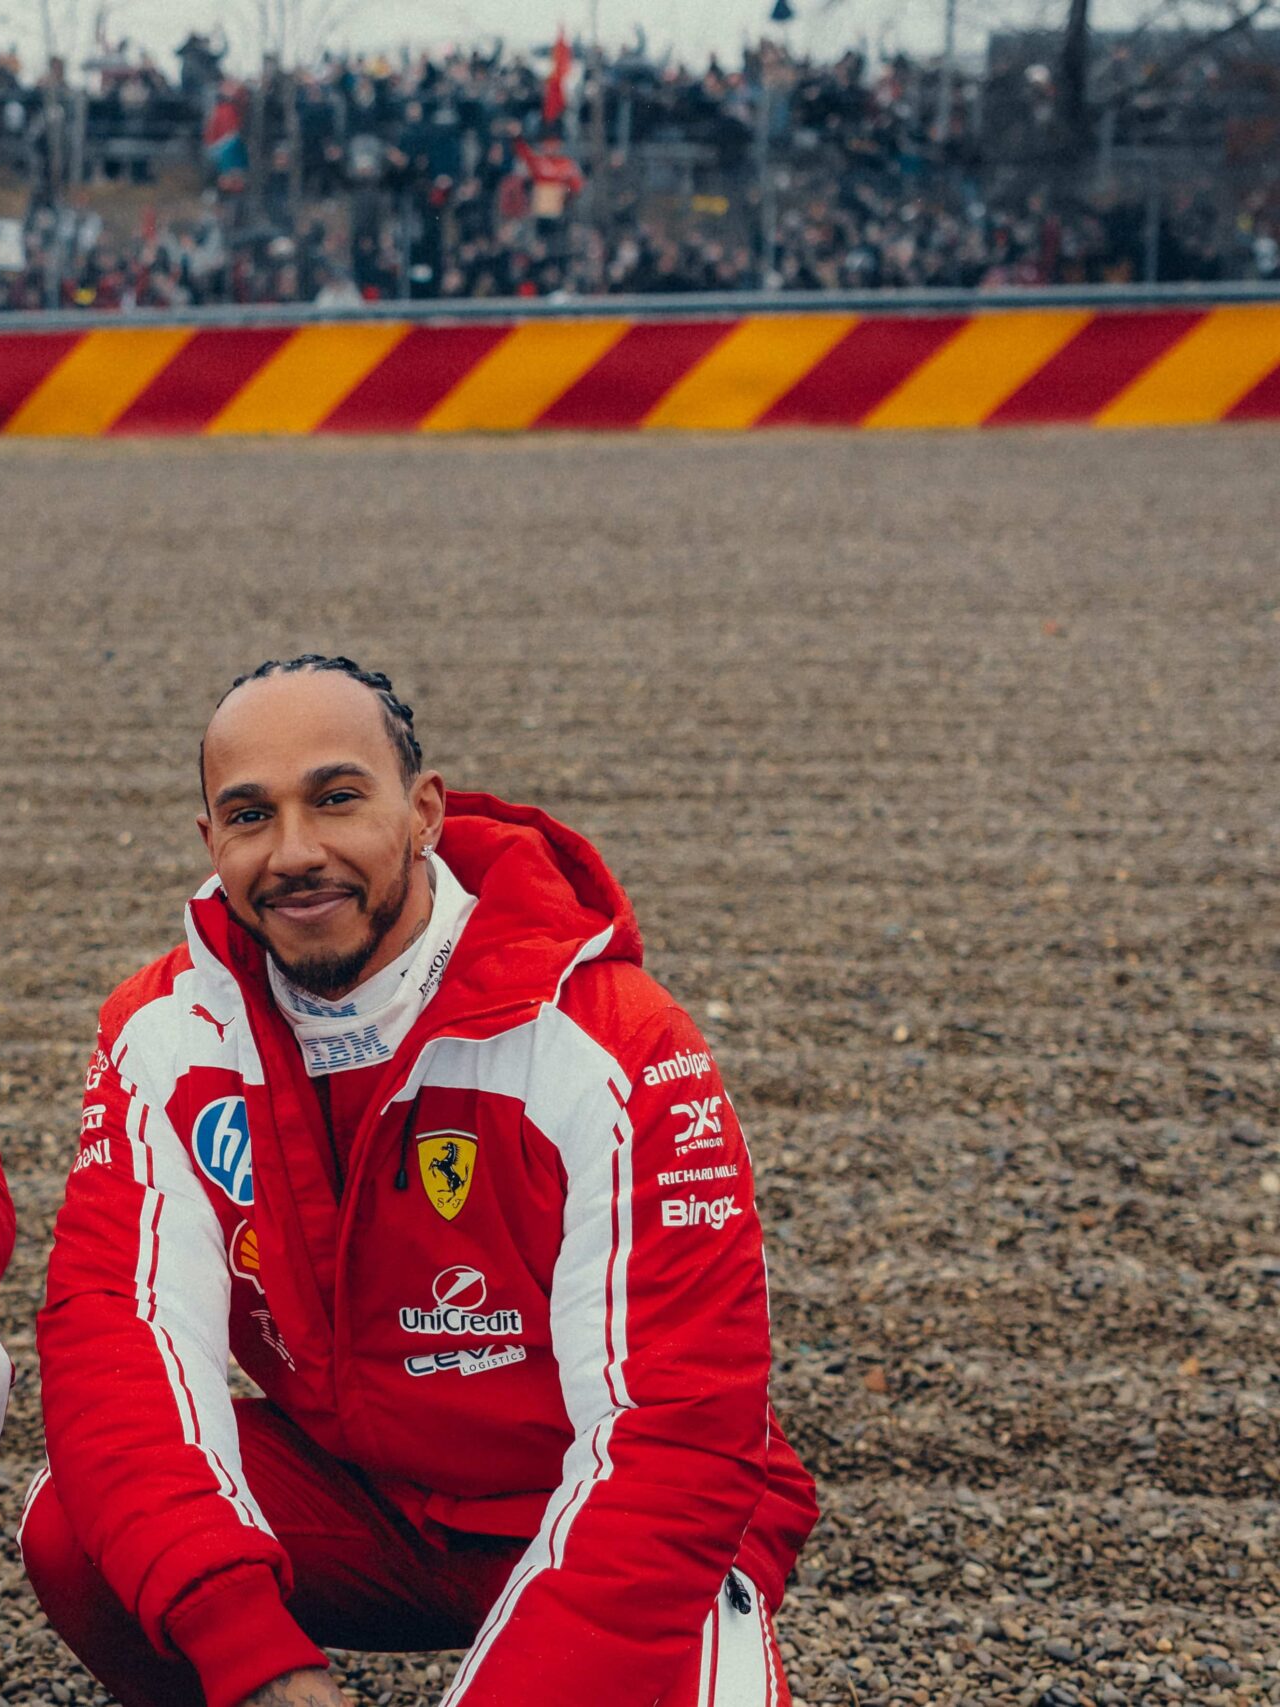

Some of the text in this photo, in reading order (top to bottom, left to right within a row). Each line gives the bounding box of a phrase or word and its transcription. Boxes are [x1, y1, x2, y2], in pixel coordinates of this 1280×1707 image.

[303, 1024, 390, 1070] IBM
[657, 1166, 713, 1186] RICHARD
[401, 1308, 521, 1334] UniCredit
[462, 1351, 525, 1374] LOGISTICS
